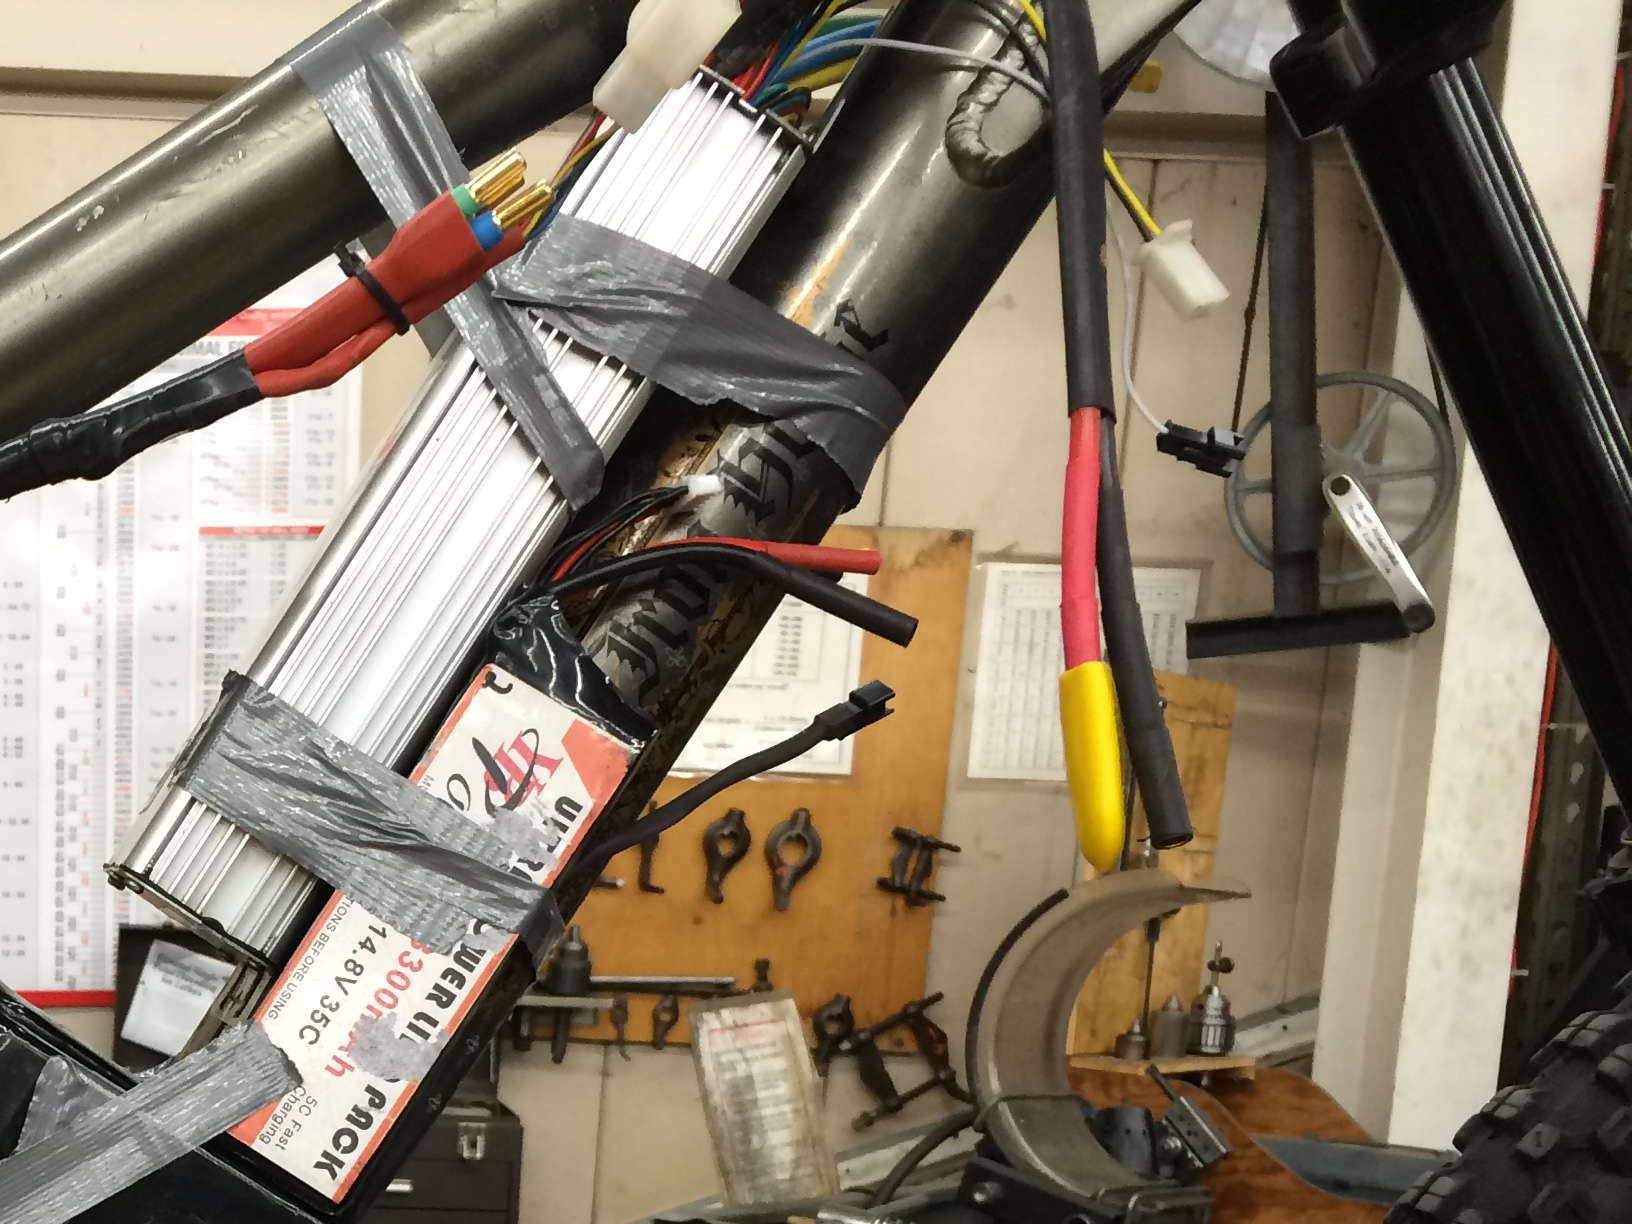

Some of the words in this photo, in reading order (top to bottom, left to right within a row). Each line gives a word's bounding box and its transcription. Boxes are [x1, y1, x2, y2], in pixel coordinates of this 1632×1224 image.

[290, 931, 333, 985] BEFORE
[327, 919, 389, 996] 14.8V
[294, 991, 343, 1048] 35C
[255, 1081, 308, 1148] Charging
[273, 1117, 303, 1153] Fast
[295, 1094, 319, 1121] 5C
[311, 1083, 392, 1183] PACK
